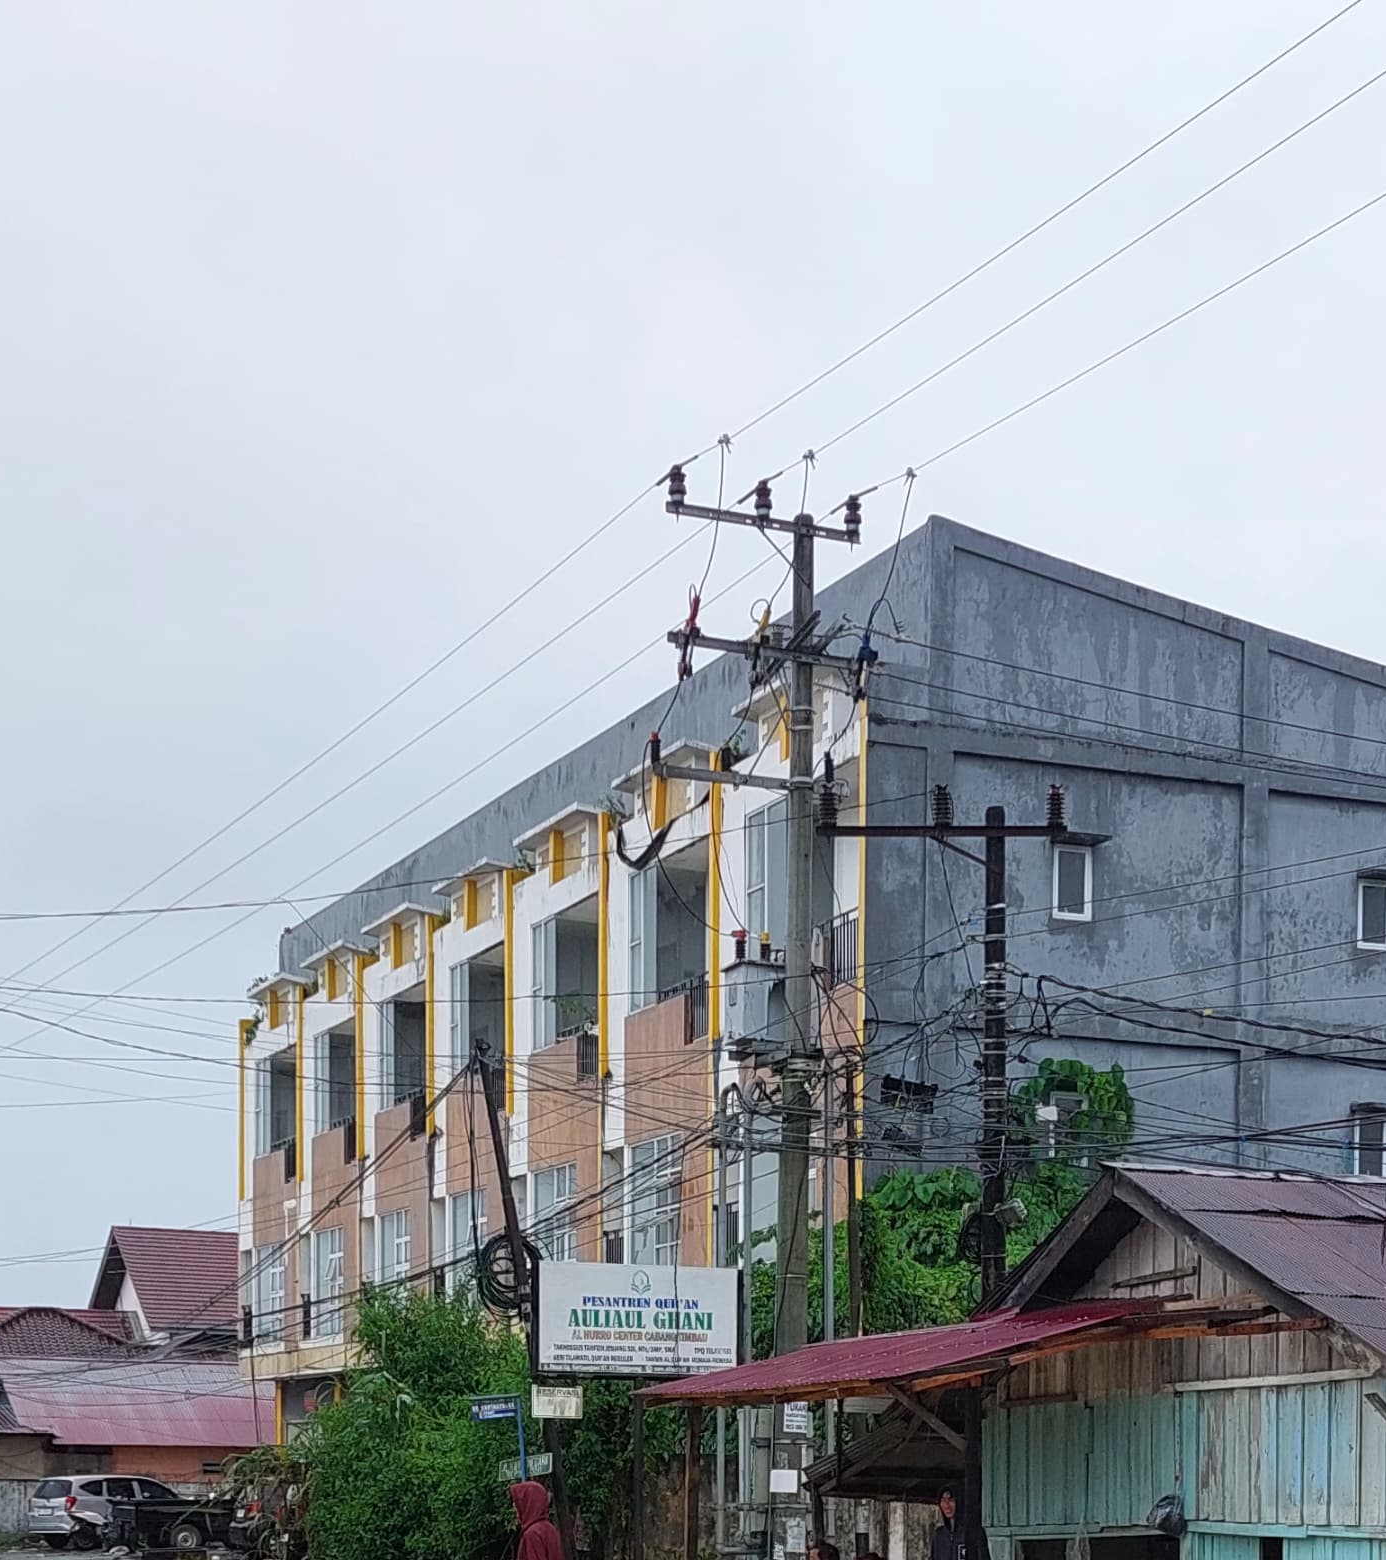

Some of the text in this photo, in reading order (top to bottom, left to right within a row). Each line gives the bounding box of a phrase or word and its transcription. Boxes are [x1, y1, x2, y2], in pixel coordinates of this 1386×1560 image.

[582, 1296, 650, 1308] PESANTREN
[569, 1309, 712, 1330] AULIAUL GHANI
